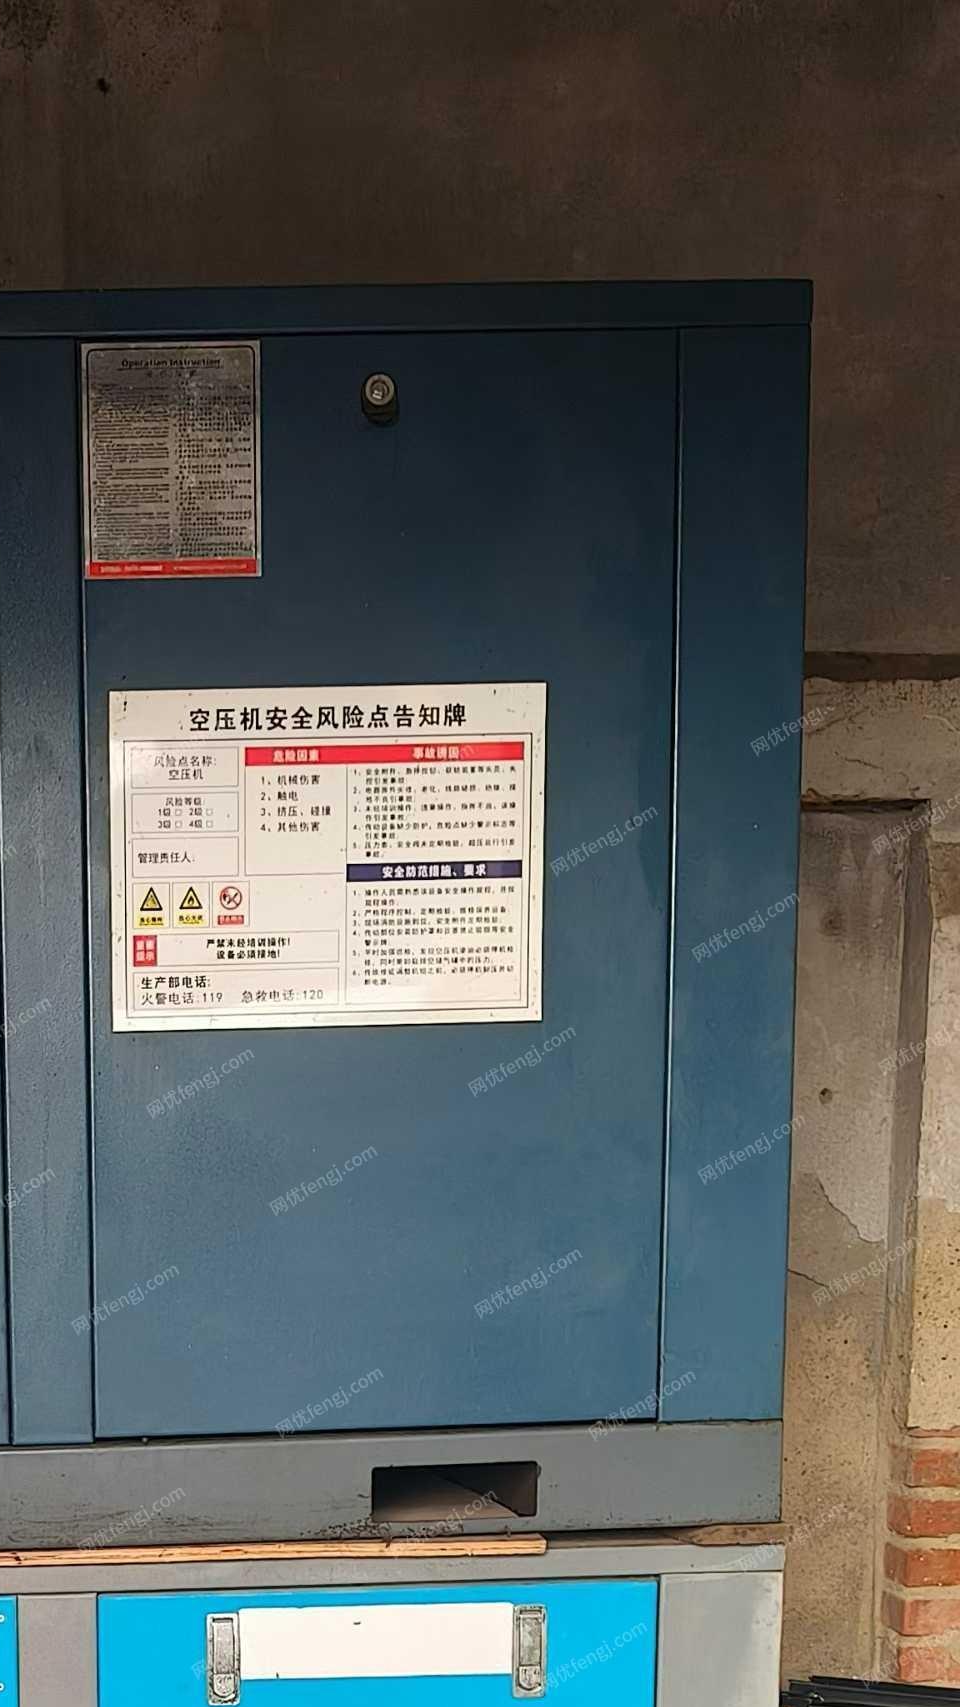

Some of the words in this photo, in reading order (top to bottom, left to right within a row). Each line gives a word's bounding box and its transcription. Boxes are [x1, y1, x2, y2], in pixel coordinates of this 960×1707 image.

[189, 701, 468, 732] 空压机安全风险点告知牌
[168, 768, 204, 781] 空压机
